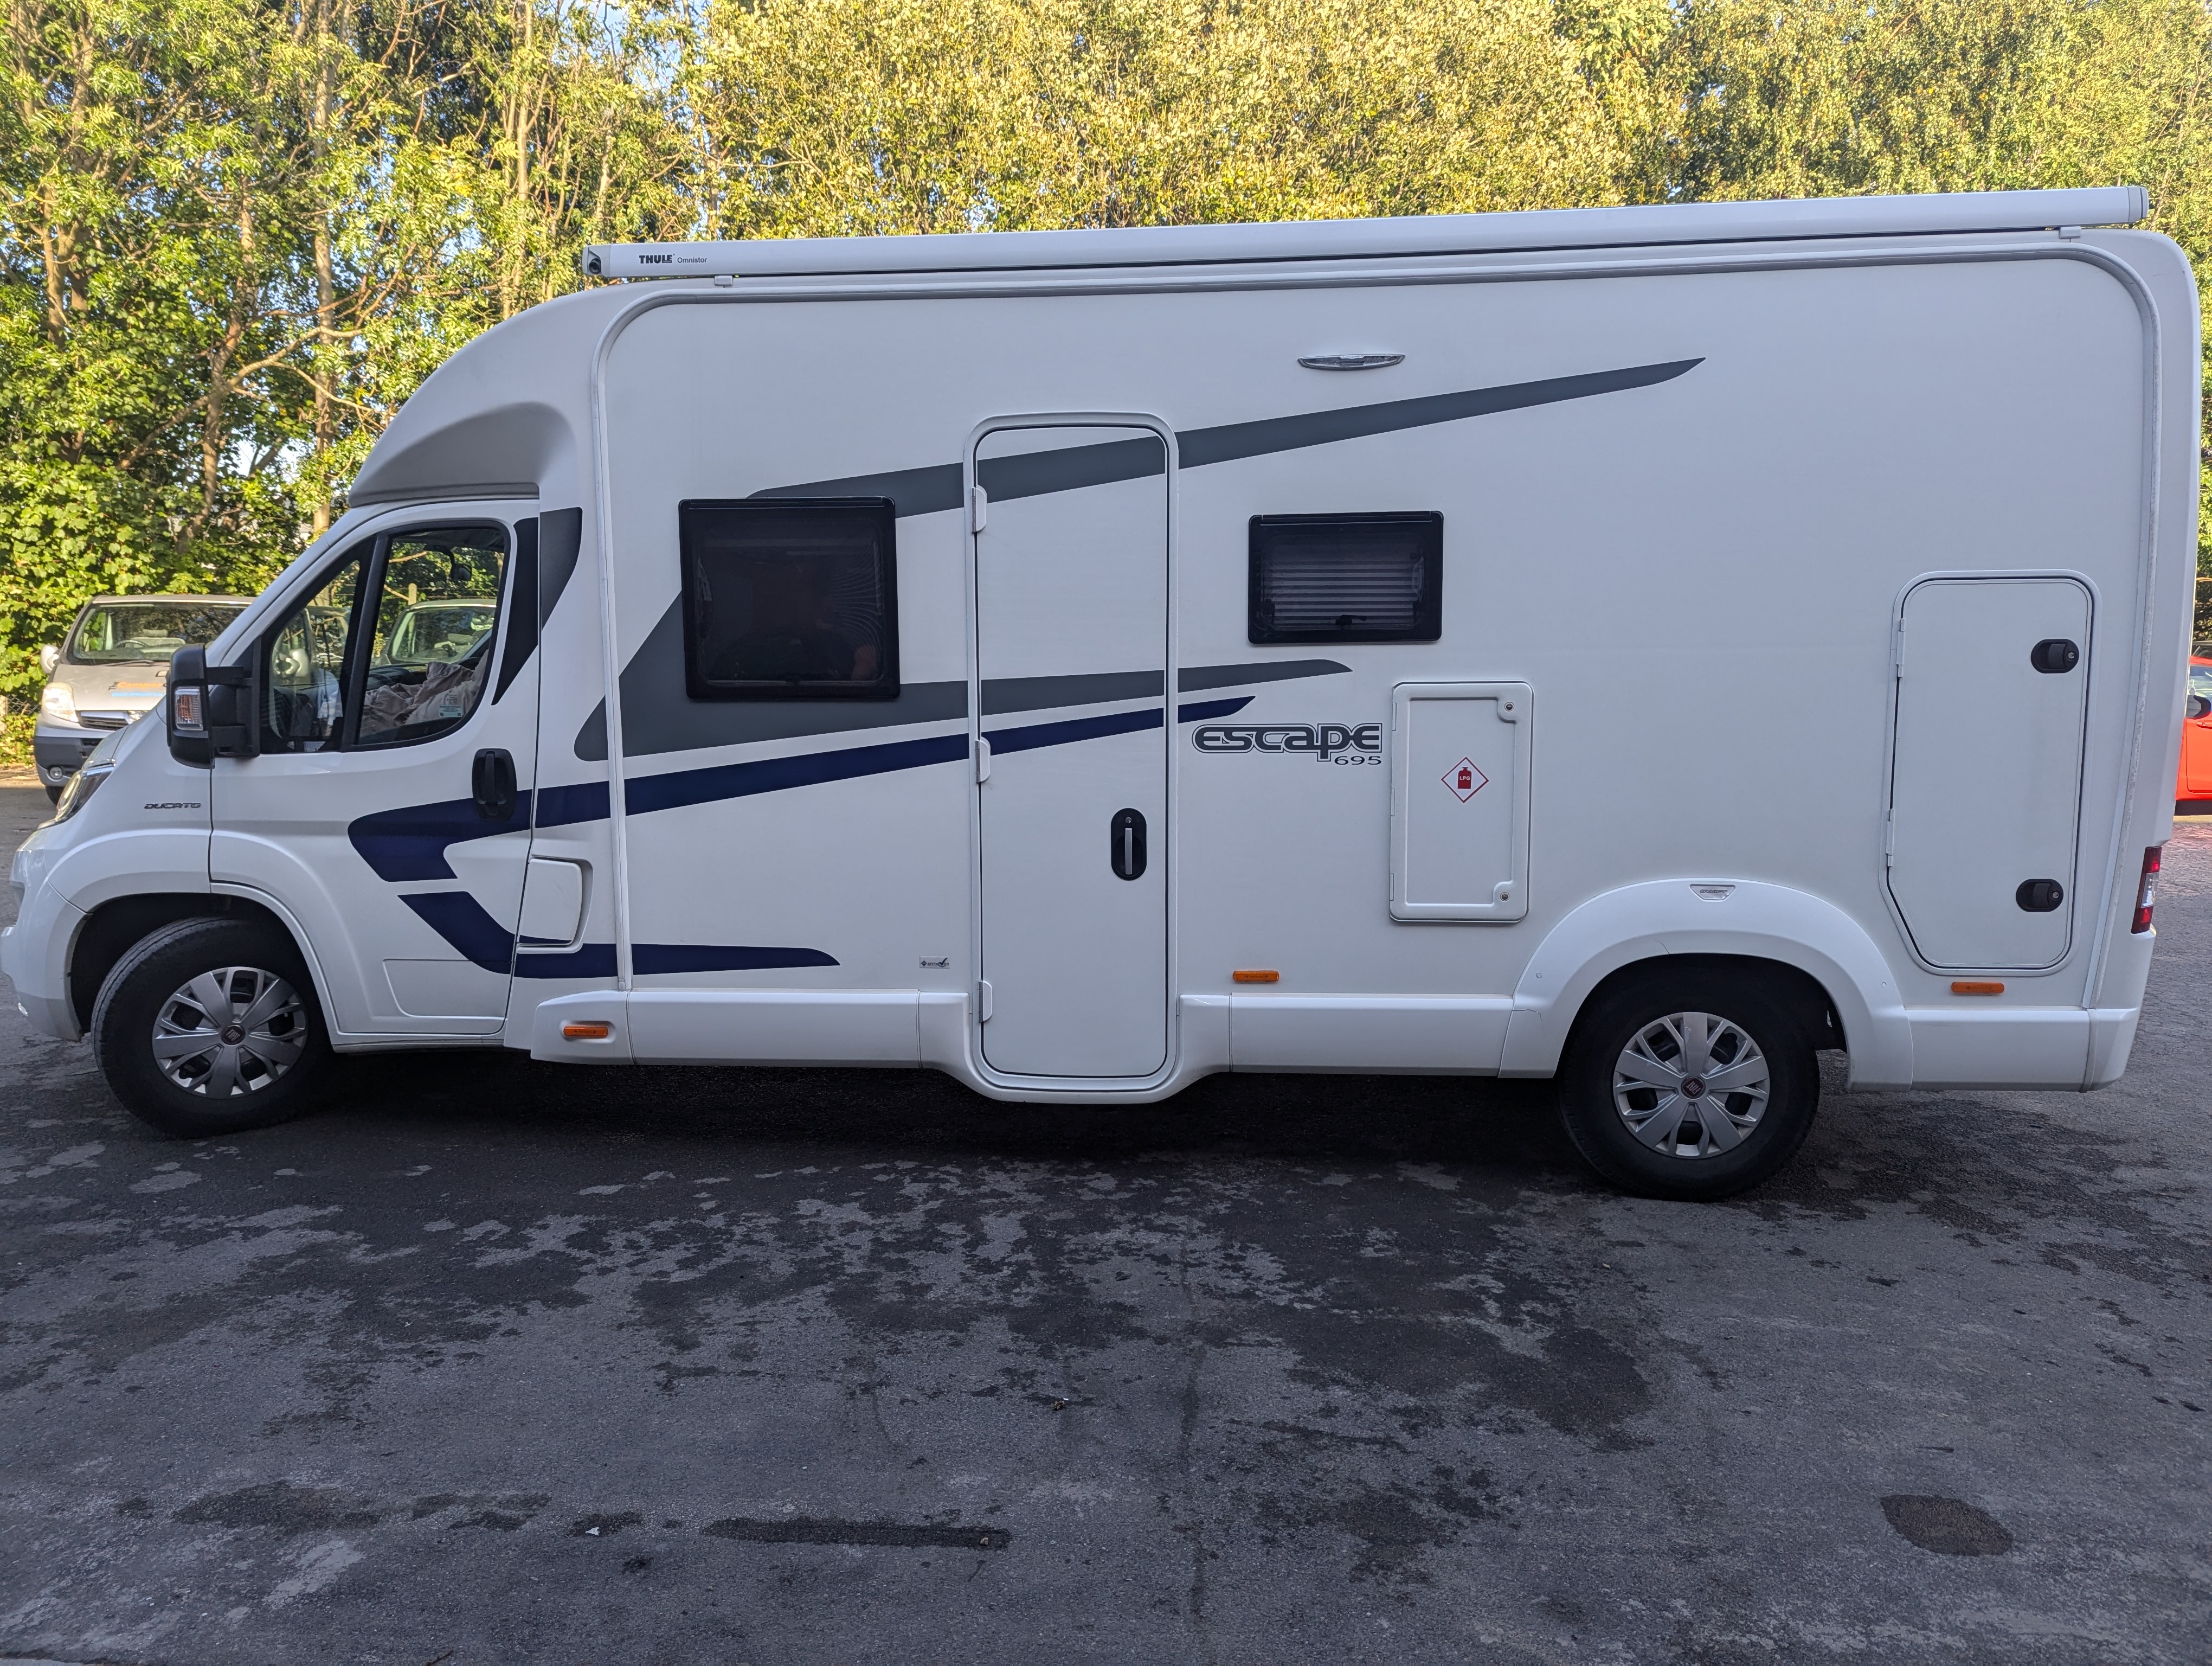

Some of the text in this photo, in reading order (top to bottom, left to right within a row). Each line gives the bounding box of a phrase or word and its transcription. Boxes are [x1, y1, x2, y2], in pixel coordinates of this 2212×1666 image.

[639, 254, 673, 264] THULE
[1334, 755, 1382, 765] 695
[1686, 1081, 1701, 1095] FIAT
